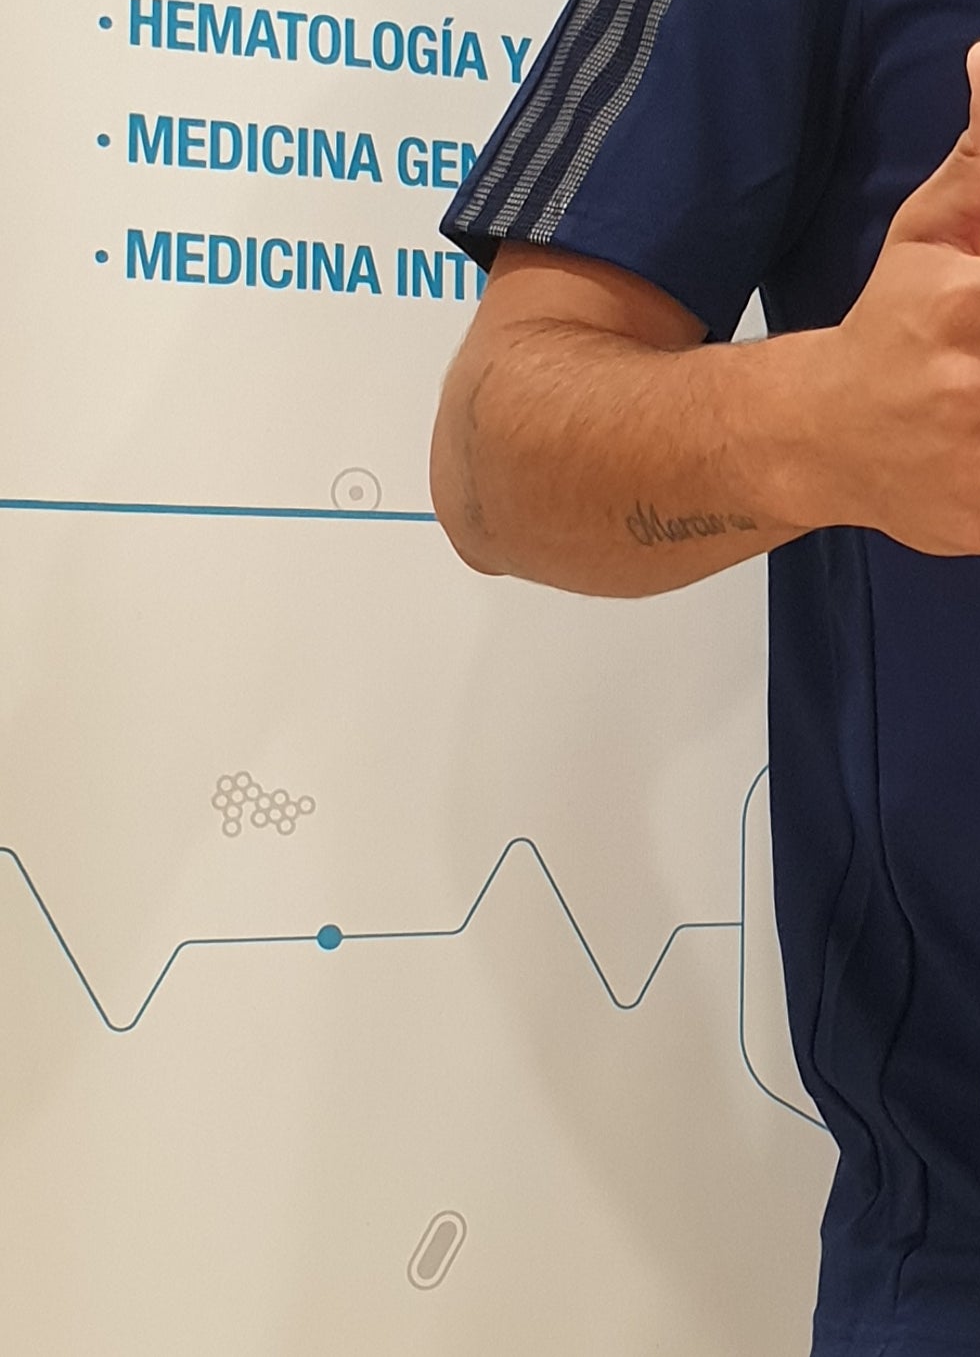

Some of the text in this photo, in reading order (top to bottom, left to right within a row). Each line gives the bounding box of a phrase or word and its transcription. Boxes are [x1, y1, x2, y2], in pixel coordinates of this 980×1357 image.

[501, 35, 532, 84] Y
[127, 112, 383, 184] MEDICINA
[125, 229, 382, 296] MEDICINA
